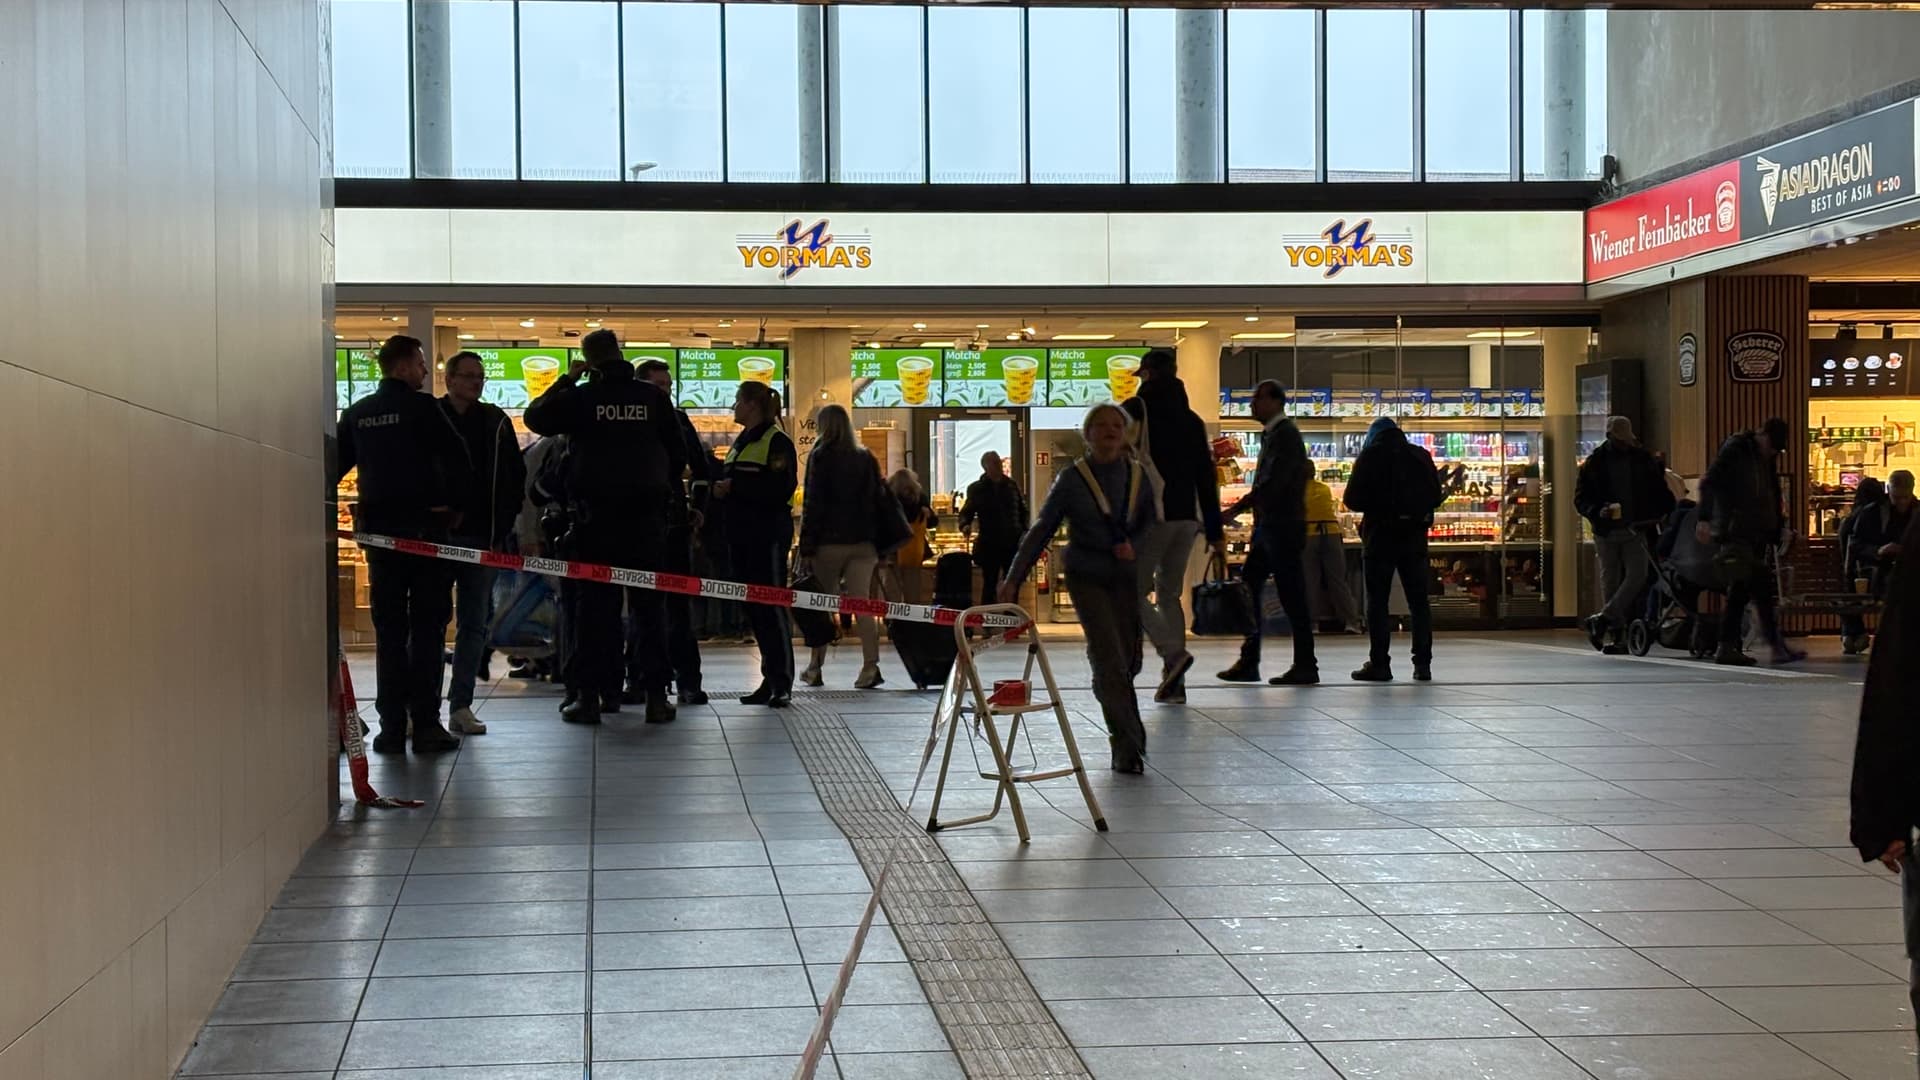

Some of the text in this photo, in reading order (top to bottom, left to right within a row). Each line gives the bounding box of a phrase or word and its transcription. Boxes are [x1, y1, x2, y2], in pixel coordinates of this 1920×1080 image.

[1779, 142, 1873, 202] ASIADRAGON
[1811, 183, 1873, 214] BEST OF ASIA
[1589, 197, 1712, 265] Wiener Feinbäcker
[737, 245, 872, 268] YORMA'S
[1283, 244, 1414, 268] YORMA'S
[681, 350, 716, 360] Matcha
[851, 351, 875, 360] atcha
[945, 351, 981, 360] Matcha
[1050, 350, 1085, 360] Matcha
[358, 413, 400, 429] POLIZEI
[596, 404, 648, 421] POLIZEI
